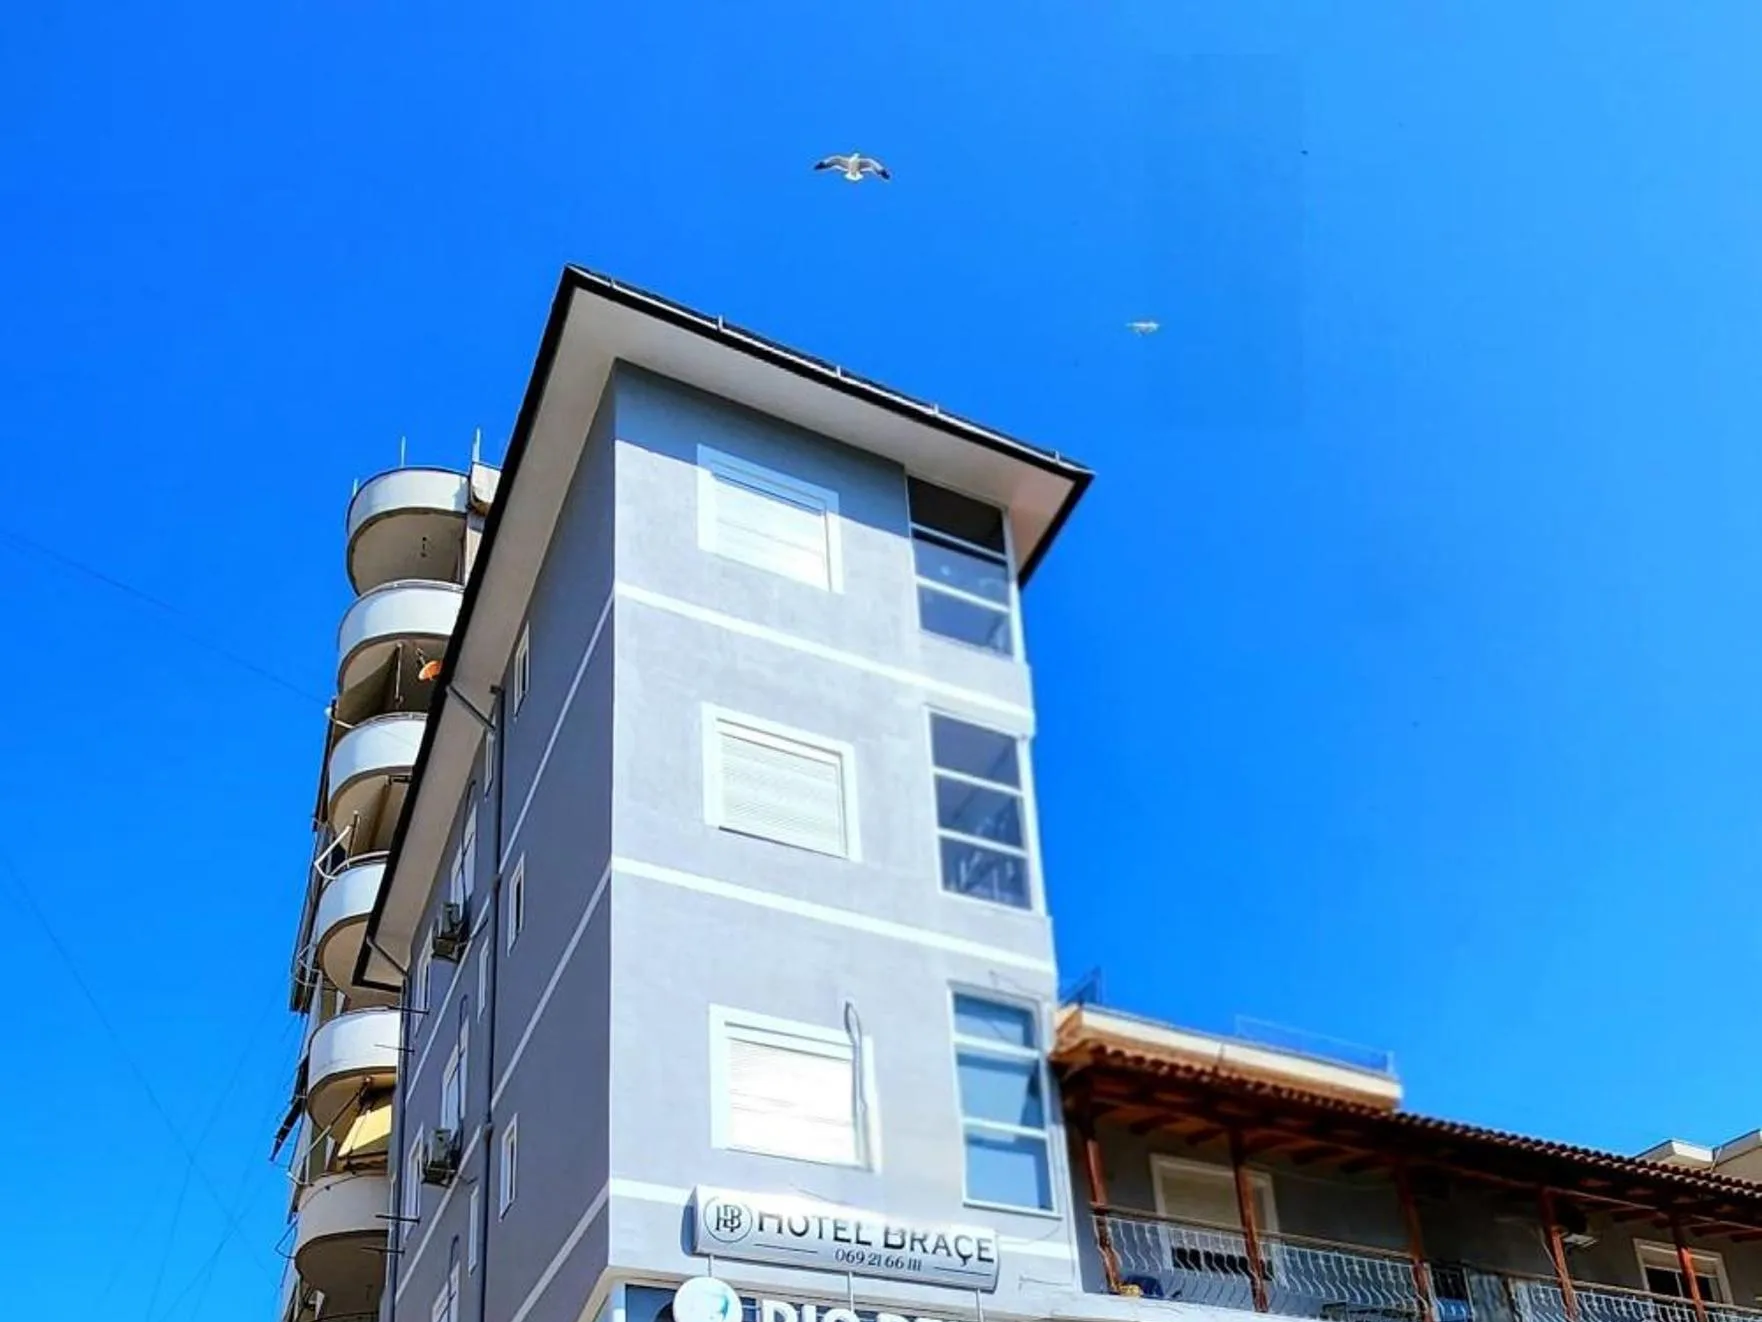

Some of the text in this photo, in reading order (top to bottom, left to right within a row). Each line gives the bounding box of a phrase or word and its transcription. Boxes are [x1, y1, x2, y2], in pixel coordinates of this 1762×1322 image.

[758, 1209, 996, 1267] HOTEL BRAÇE
[835, 1248, 865, 1267] 069
[867, 1252, 882, 1268] 21
[884, 1254, 905, 1270] 66
